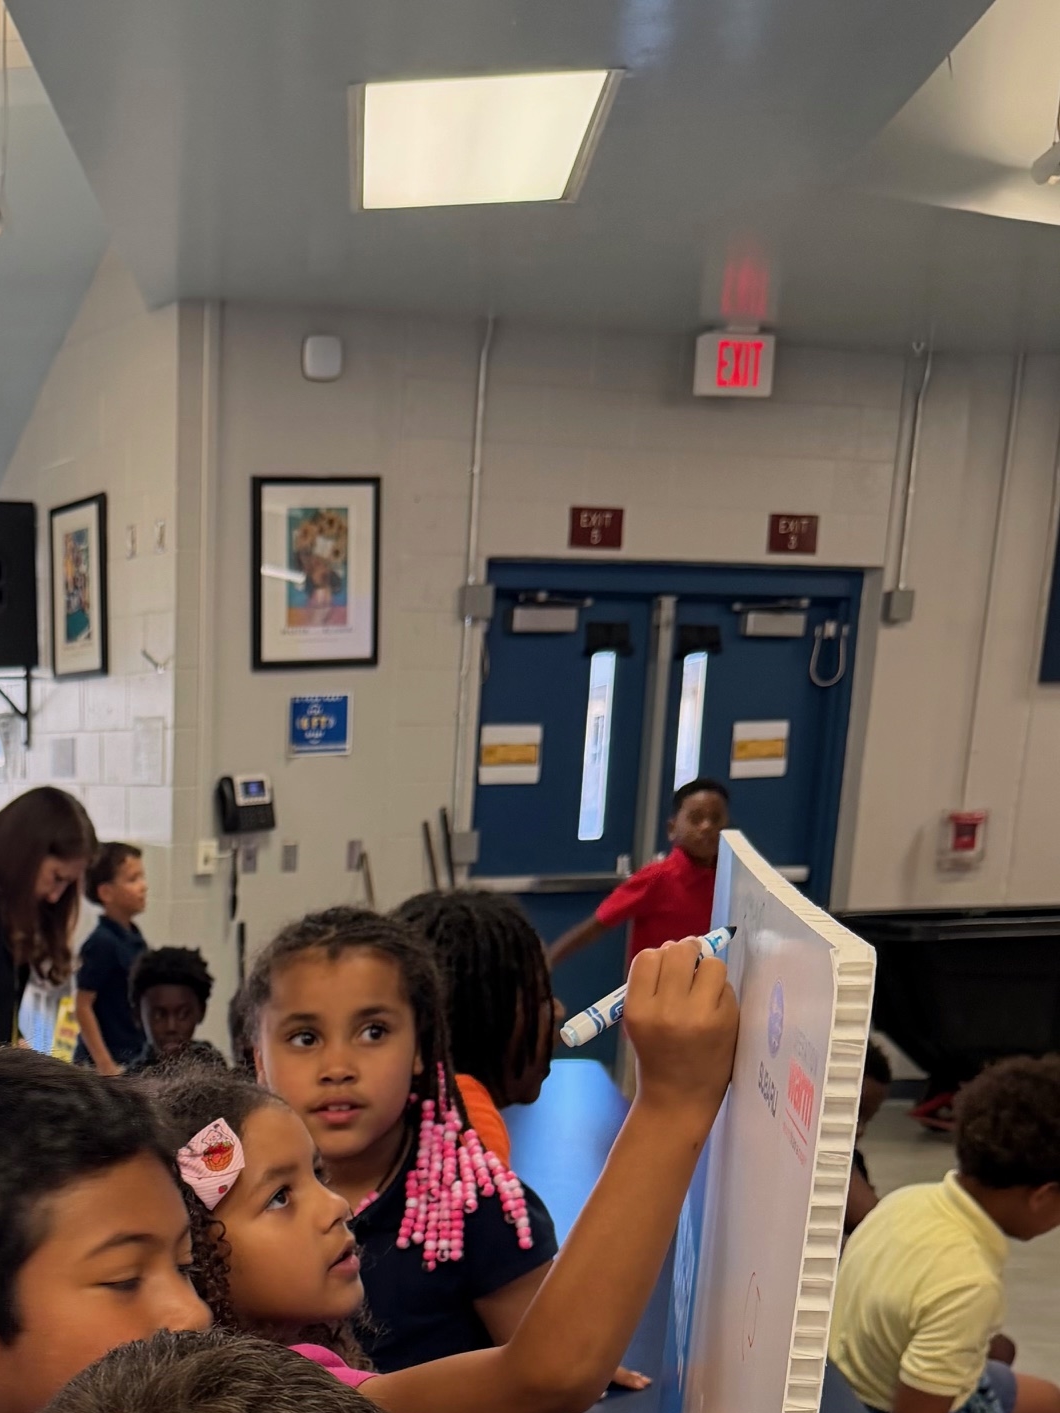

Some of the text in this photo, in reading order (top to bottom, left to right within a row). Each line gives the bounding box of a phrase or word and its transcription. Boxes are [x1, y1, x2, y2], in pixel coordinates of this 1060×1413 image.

[716, 340, 764, 388] EXIT
[580, 510, 613, 529] EXIT
[778, 517, 810, 535] EXIT
[758, 1060, 779, 1118] SUBARU
